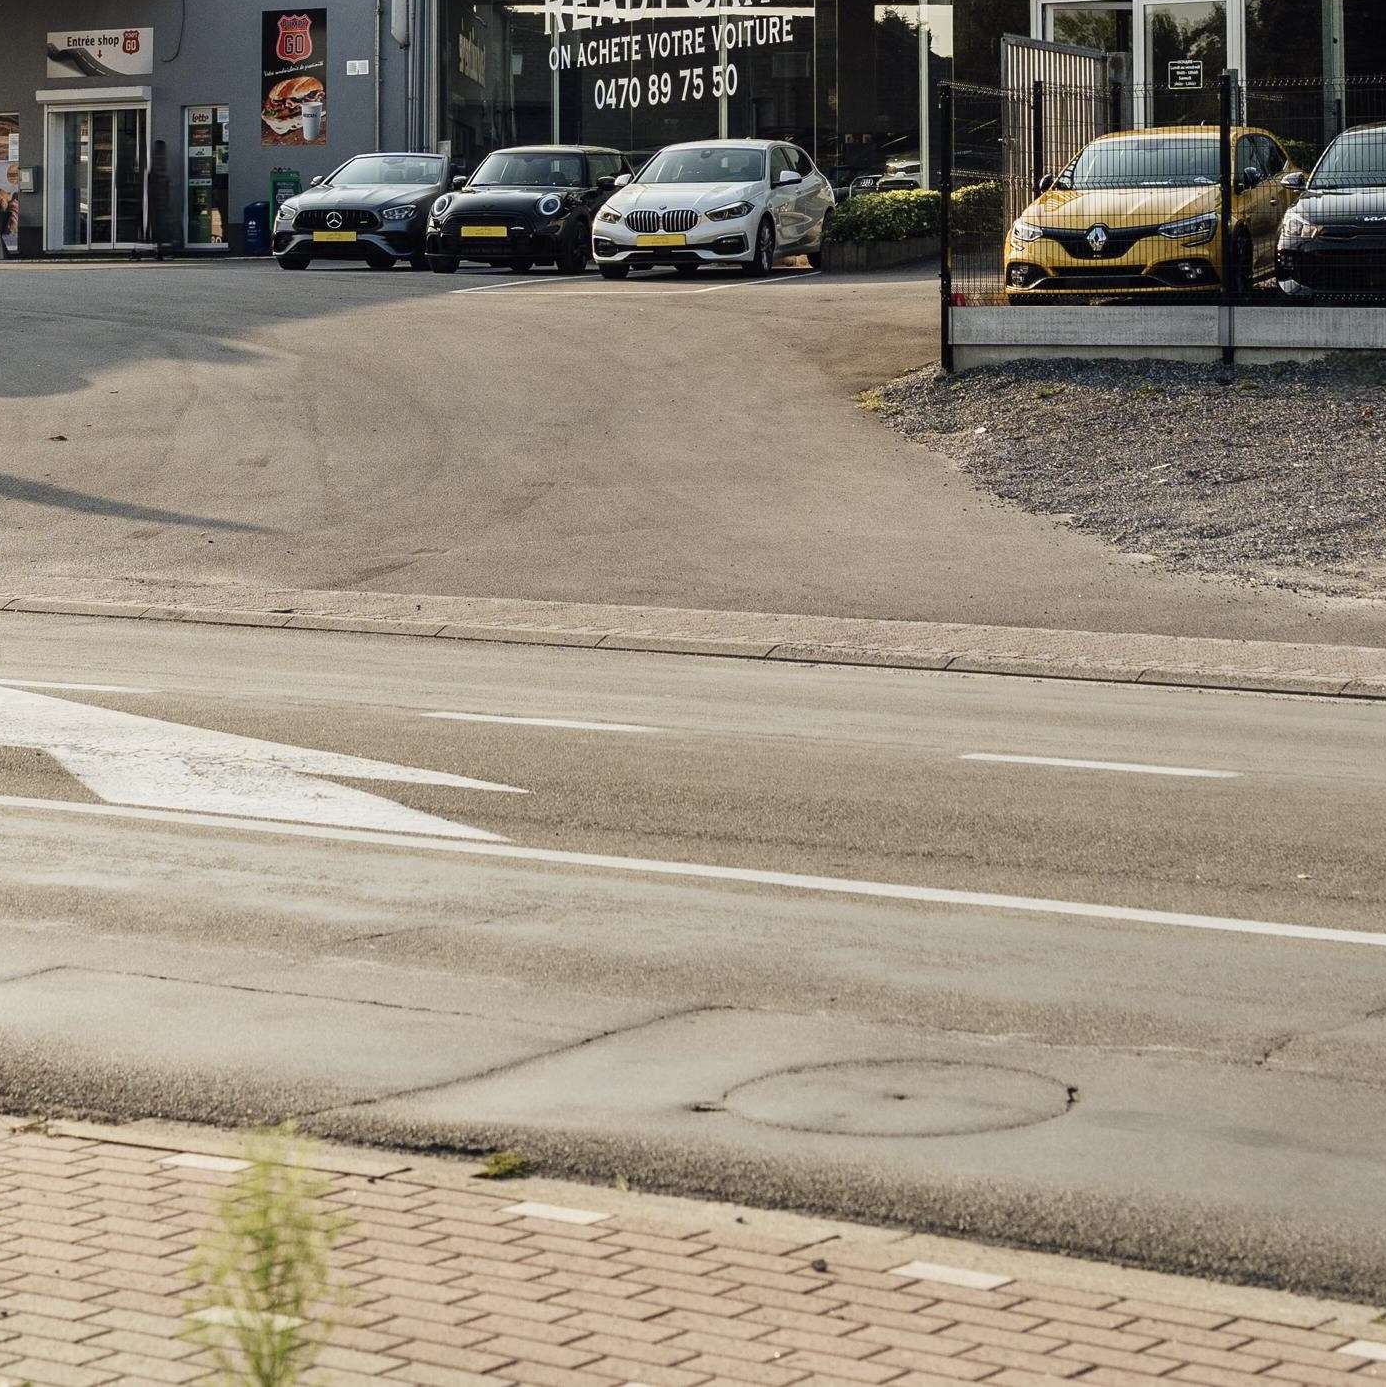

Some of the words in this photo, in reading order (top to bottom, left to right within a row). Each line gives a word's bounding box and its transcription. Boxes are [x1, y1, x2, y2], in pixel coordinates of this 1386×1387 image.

[67, 35, 95, 47] Entrée
[97, 35, 120, 47] shop
[125, 39, 137, 51] GO
[284, 34, 304, 54] GO
[549, 45, 571, 71] ON
[576, 34, 642, 68] ACHETE
[648, 27, 705, 59] VOTRE
[711, 15, 794, 52] VOITURE
[594, 77, 641, 110] 0470
[648, 72, 672, 106] 89
[679, 67, 705, 101] 75
[712, 63, 738, 98] 50
